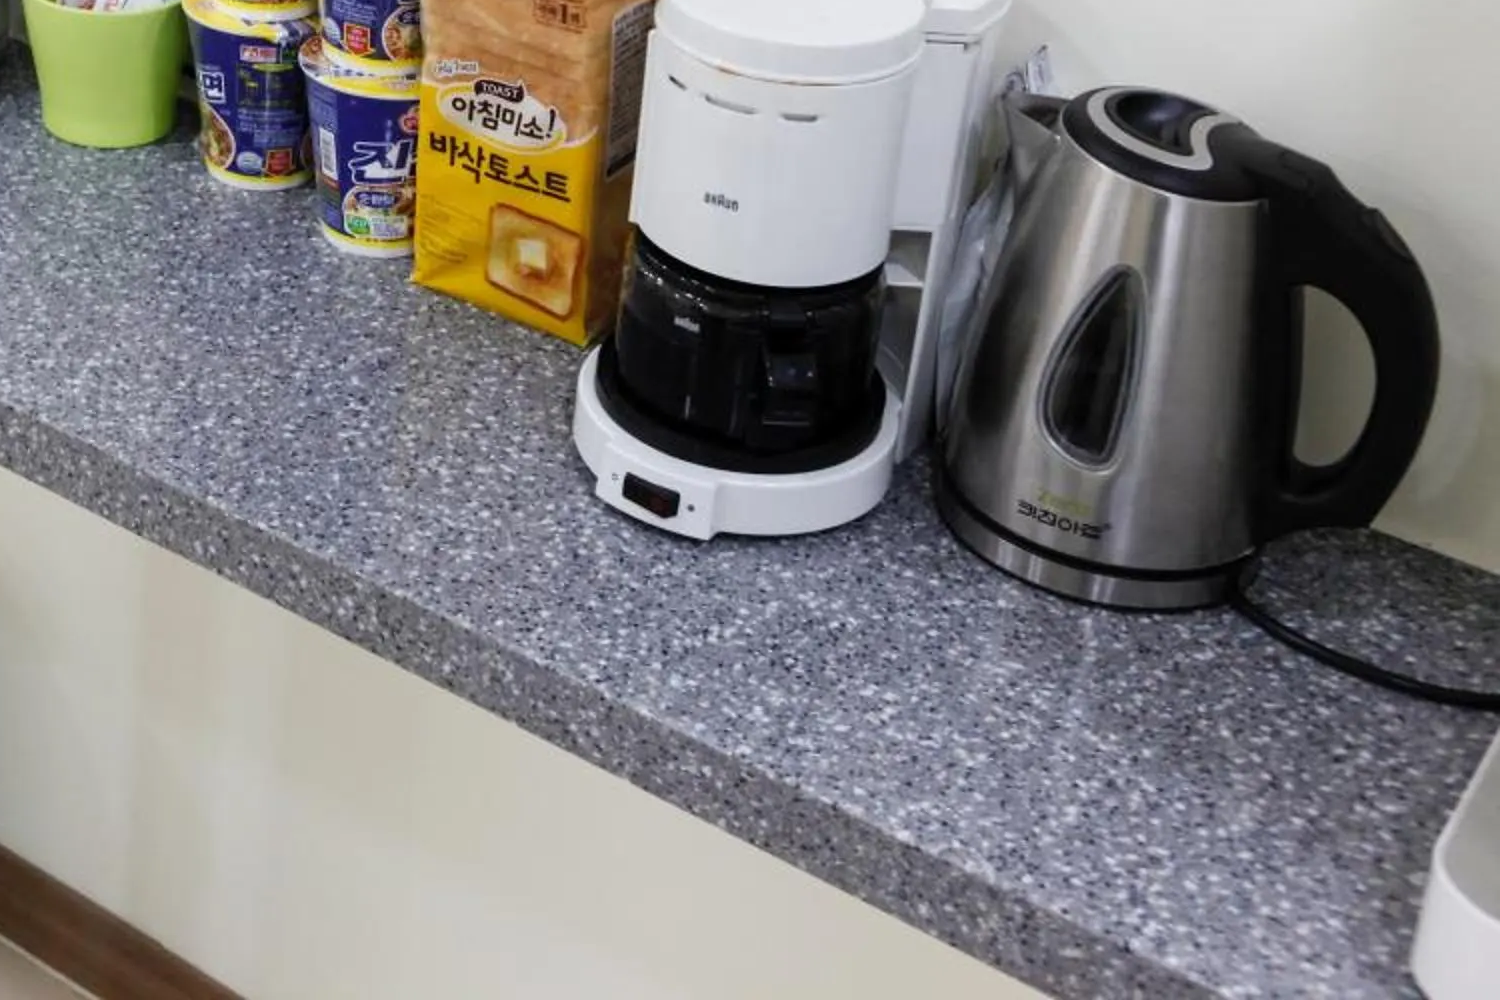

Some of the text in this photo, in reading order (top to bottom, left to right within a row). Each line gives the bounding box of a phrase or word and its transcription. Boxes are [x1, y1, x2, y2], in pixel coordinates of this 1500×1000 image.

[481, 81, 520, 99] TOAST
[451, 96, 556, 140] 아침미소!
[429, 131, 571, 203] 바삭토스트
